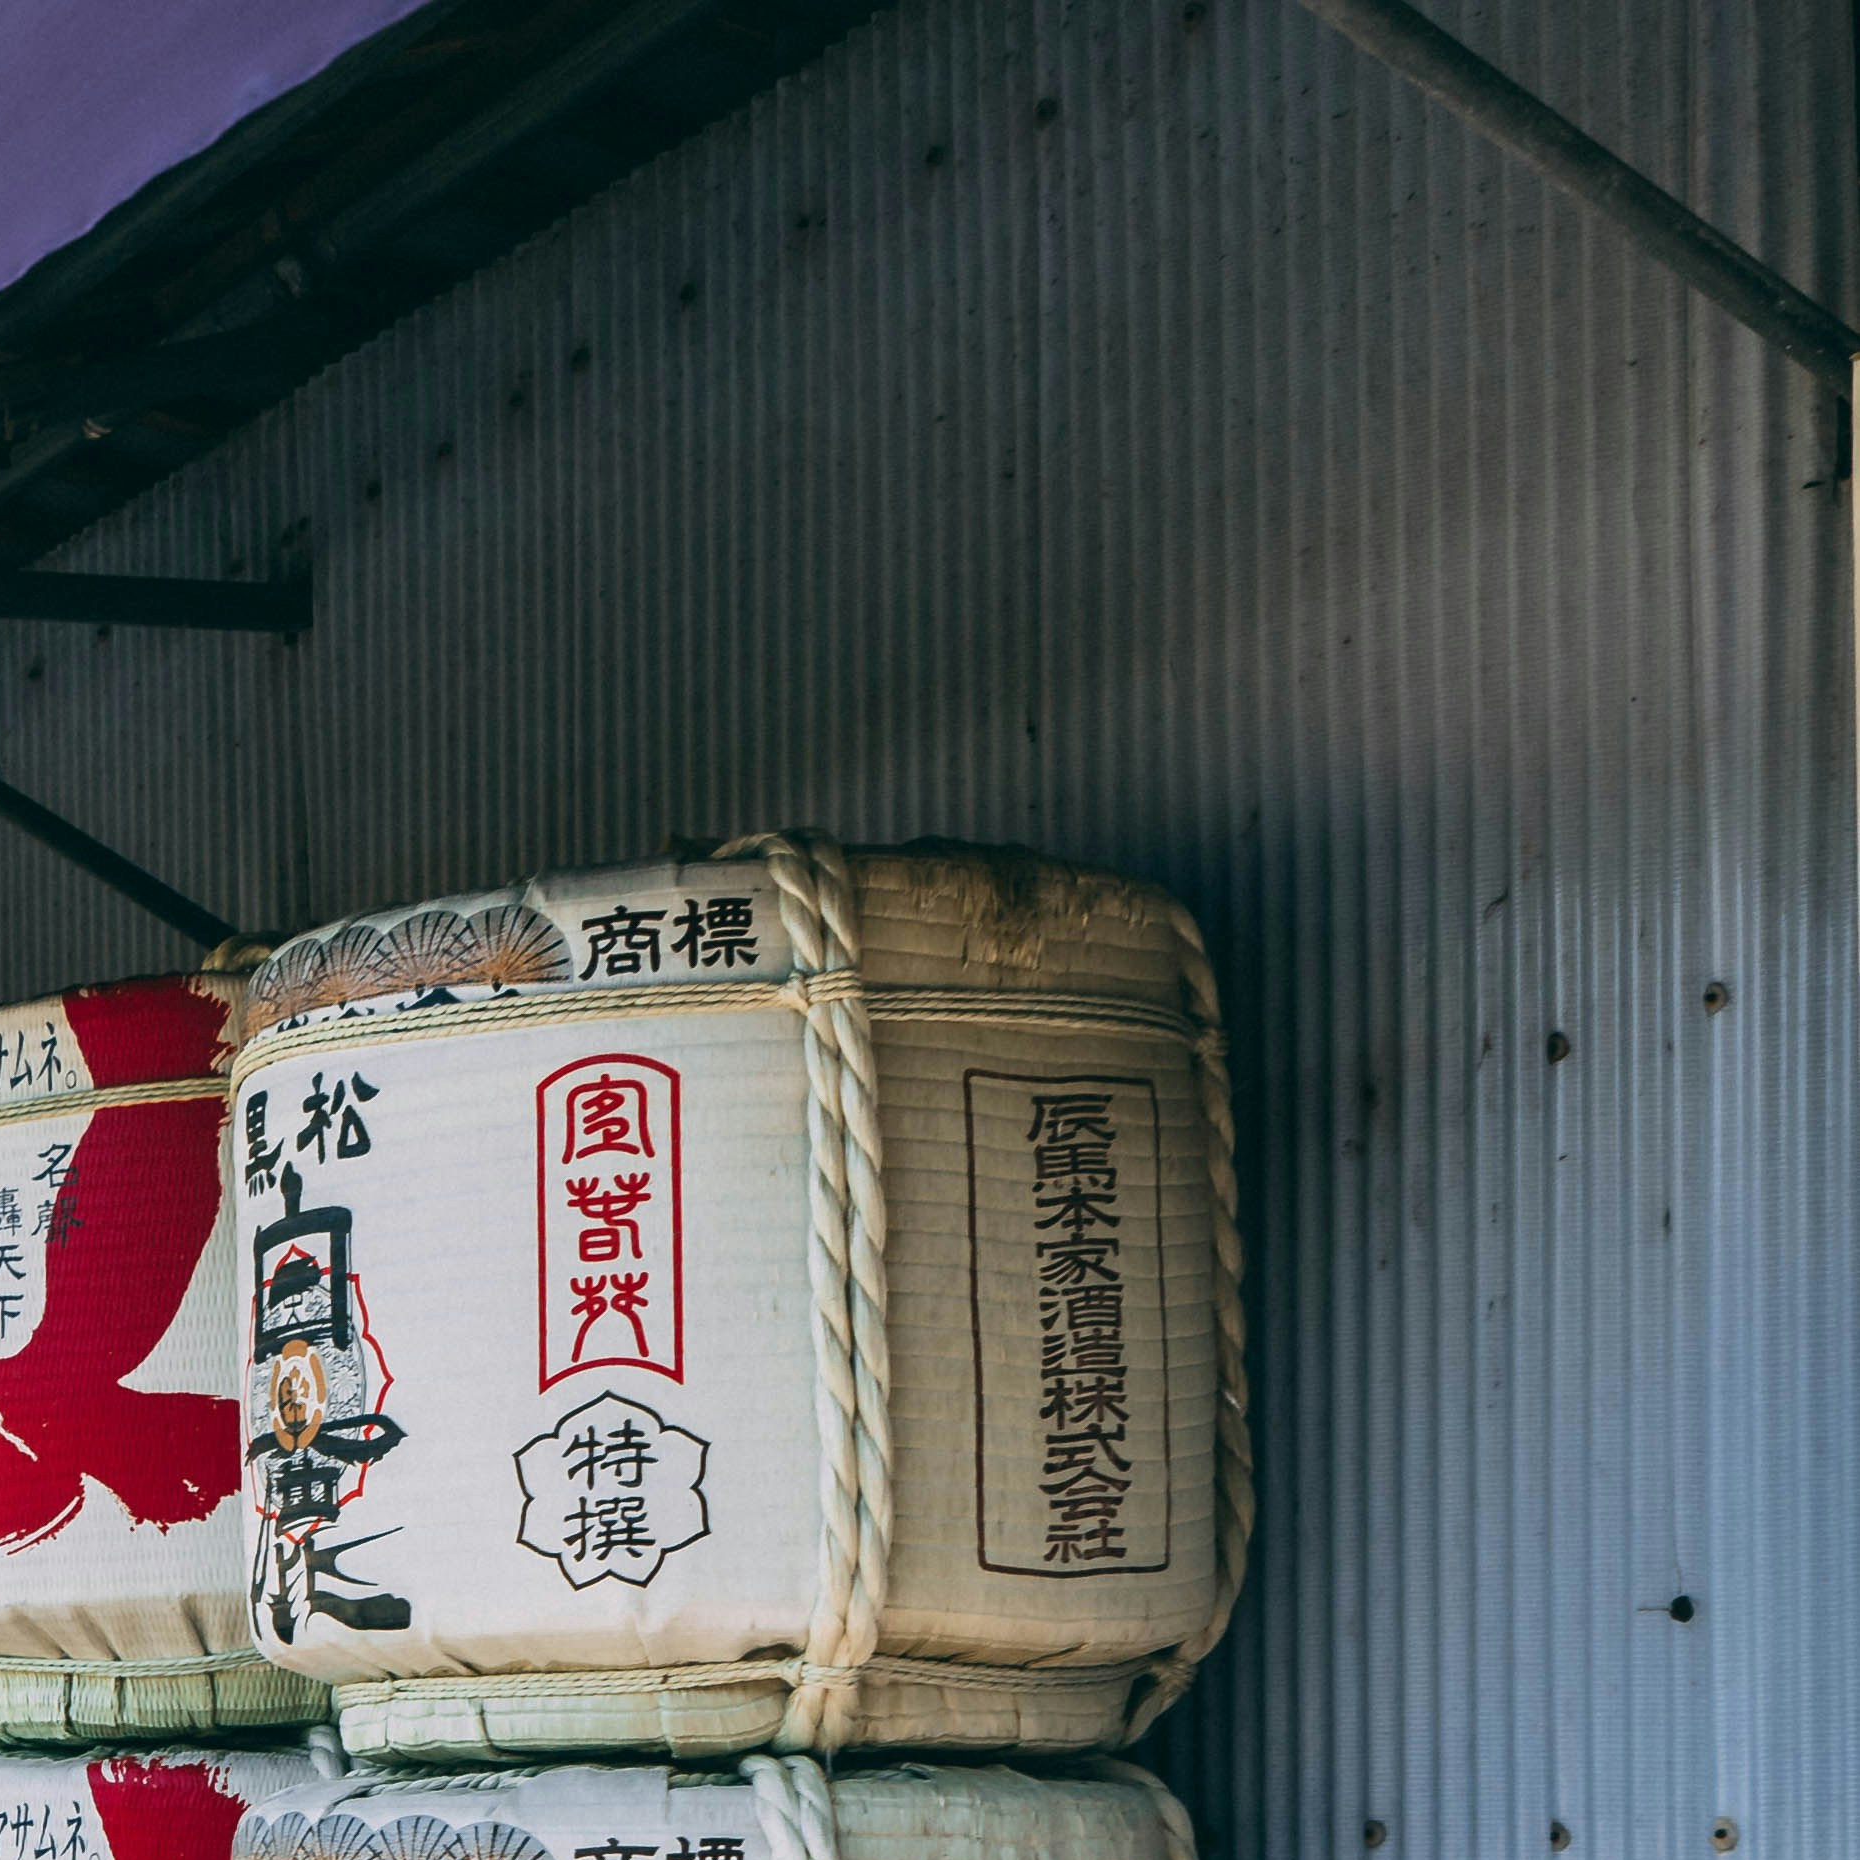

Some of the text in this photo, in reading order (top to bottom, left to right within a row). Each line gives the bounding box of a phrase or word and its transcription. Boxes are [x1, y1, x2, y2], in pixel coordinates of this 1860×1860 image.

[579, 896, 759, 981] 商標
[245, 1069, 380, 1198] 黒松
[1027, 1093, 1132, 1562] 辰馬本家酒造株式会社
[564, 1419, 658, 1561] 特撰
